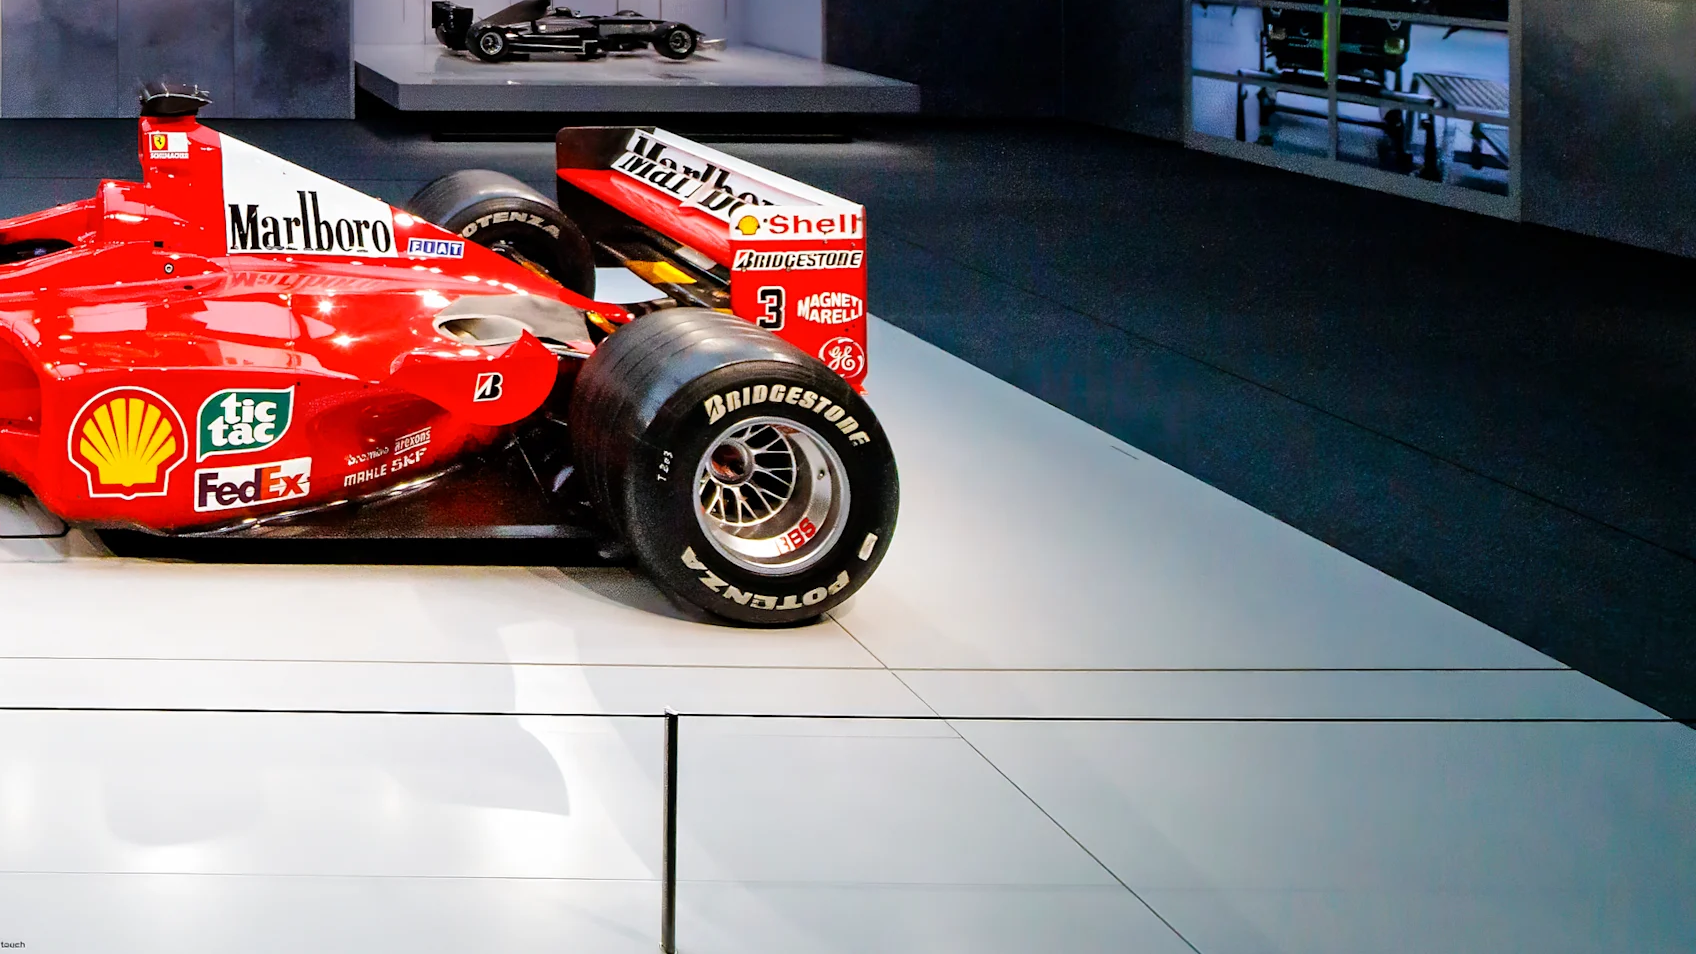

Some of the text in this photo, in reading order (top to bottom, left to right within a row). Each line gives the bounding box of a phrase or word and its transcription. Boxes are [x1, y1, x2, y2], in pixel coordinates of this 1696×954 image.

[228, 190, 391, 253] Marlboro
[457, 211, 561, 240] OTENZA
[768, 213, 858, 234] Shell
[409, 239, 464, 257] FIAT
[736, 251, 862, 269] BRIDGESTONE
[758, 287, 785, 330] 3
[797, 292, 863, 310] MAGNETI
[797, 307, 863, 324] MARELLI
[220, 392, 277, 424] tic
[704, 384, 871, 447] BRIDGESTONE
[207, 415, 275, 447] tac
[394, 429, 431, 452] arexons
[390, 448, 427, 473] SKF
[198, 465, 305, 507] FedEx
[344, 463, 387, 487] MAHLE
[681, 545, 851, 611] POTENZA
